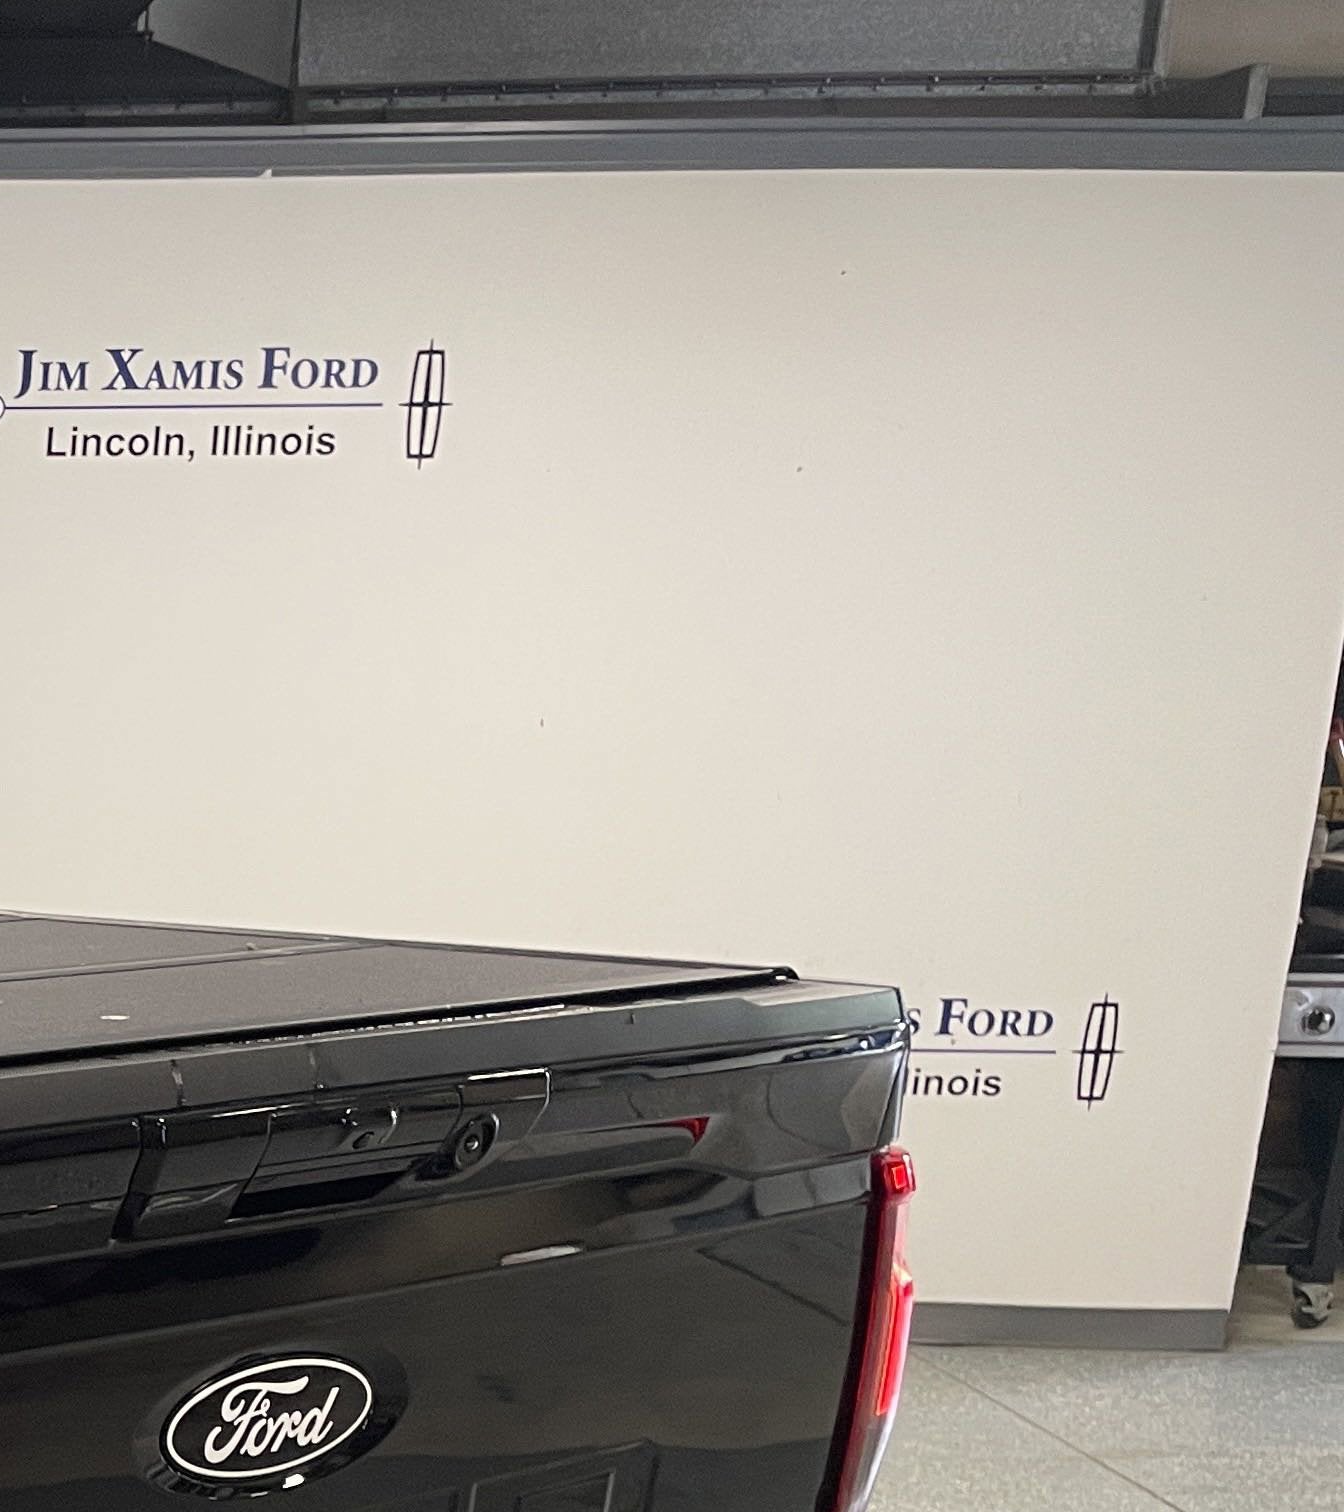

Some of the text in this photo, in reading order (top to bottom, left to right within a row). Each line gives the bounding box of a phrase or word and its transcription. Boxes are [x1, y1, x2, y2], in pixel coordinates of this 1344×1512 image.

[13, 347, 379, 400] JIM XAMIS FORD
[45, 424, 336, 461] Lincoln, Illinois
[934, 998, 1054, 1037] FORD
[910, 1068, 1002, 1097] inois
[204, 1375, 342, 1465] Ford
